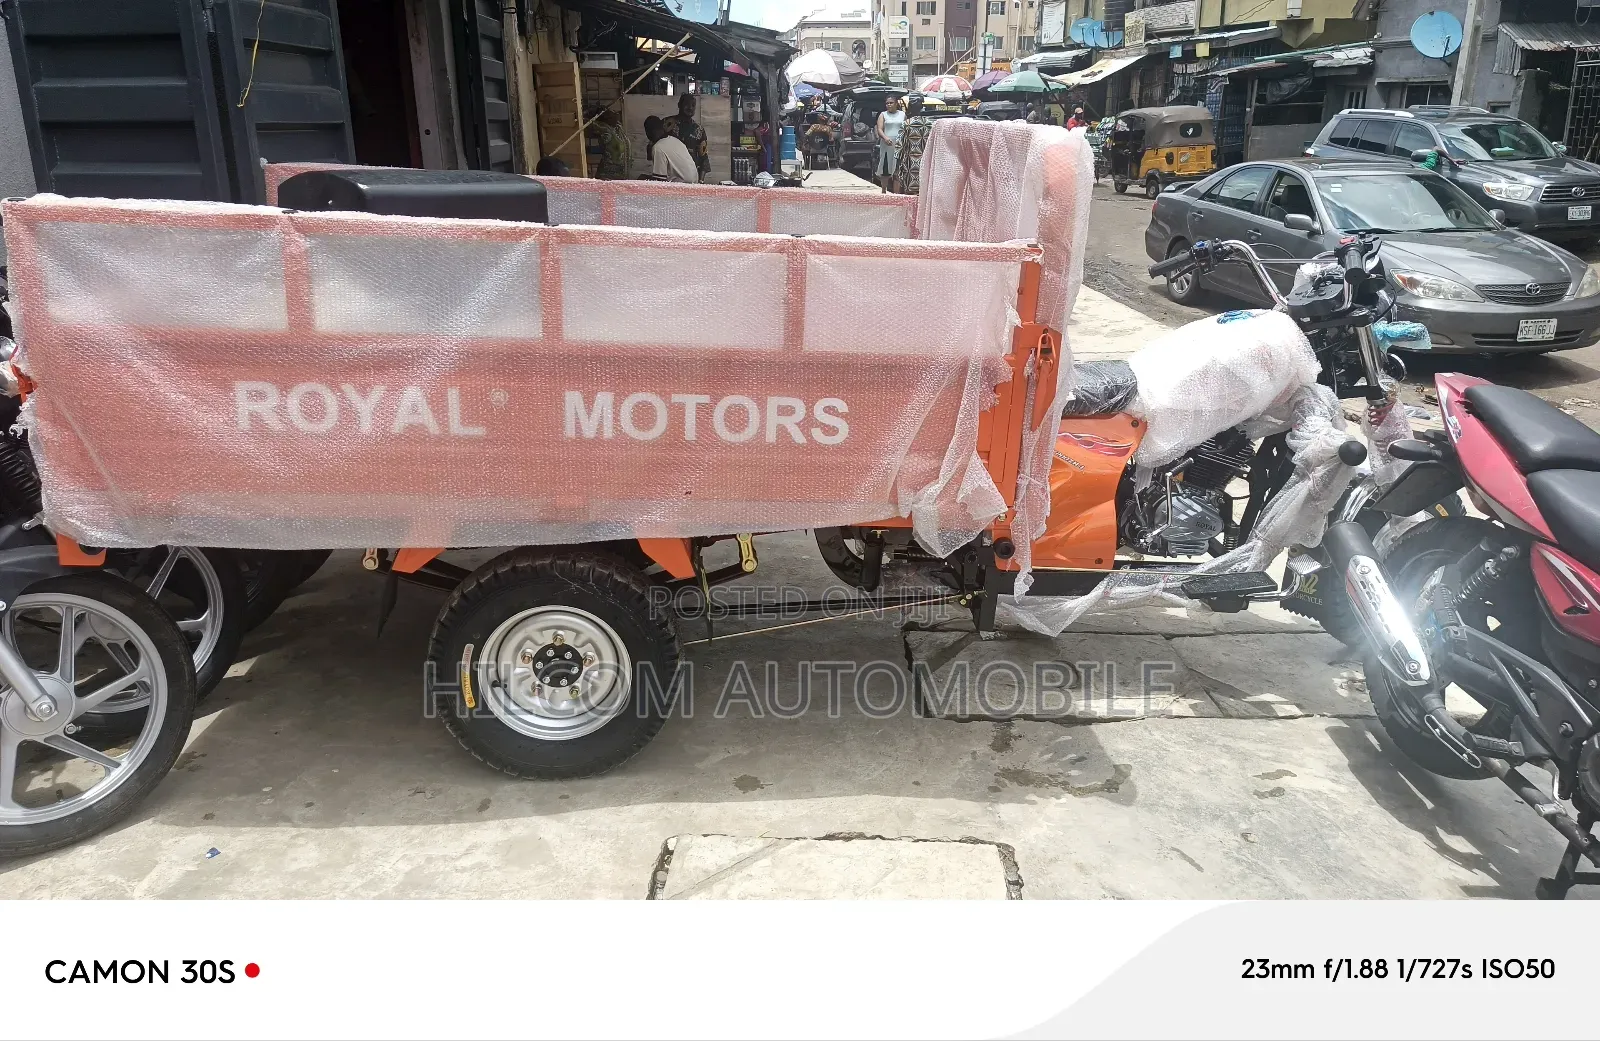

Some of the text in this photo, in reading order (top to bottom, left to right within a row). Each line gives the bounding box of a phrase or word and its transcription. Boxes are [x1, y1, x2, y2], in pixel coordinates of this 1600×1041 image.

[234, 380, 850, 445] ROYAL MOTORS
[1195, 521, 1217, 532] ROYAL
